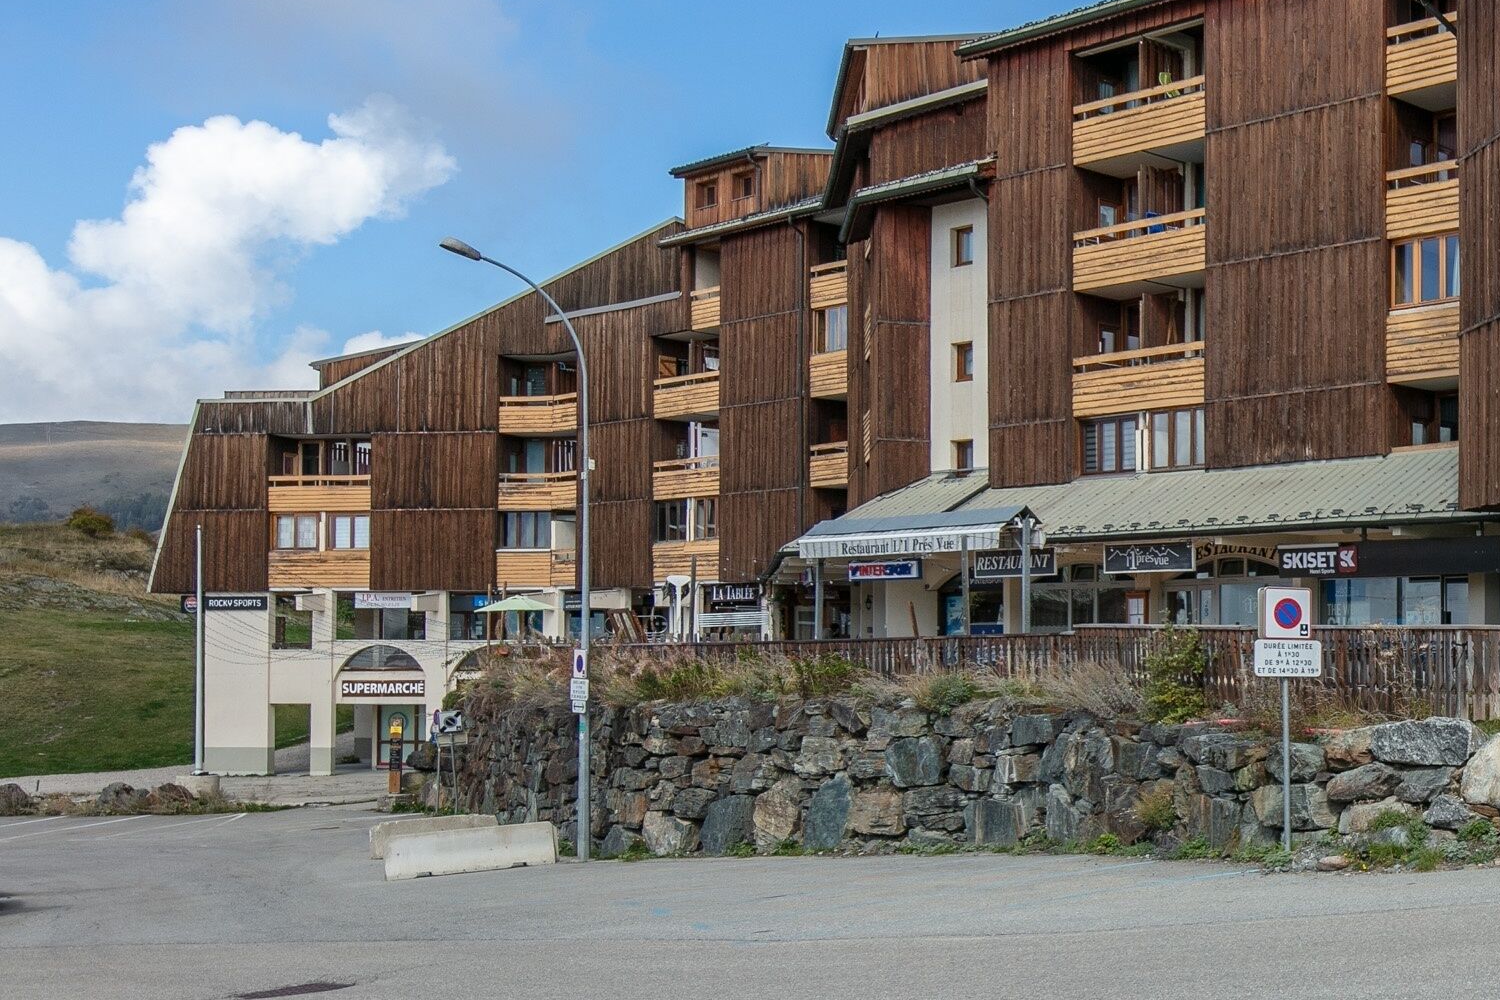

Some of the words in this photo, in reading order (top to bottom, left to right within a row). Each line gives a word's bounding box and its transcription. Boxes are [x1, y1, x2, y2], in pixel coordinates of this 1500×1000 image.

[841, 542, 889, 555] Restaurant
[936, 537, 954, 550] Vue
[1196, 542, 1278, 560] ESTAURANT
[1283, 551, 1337, 569] SKISET
[208, 599, 233, 607] ROCKY
[234, 599, 261, 607] SPORTS
[1264, 641, 1286, 649] DURÉE
[1288, 642, 1313, 650] LIMITÉE
[342, 680, 424, 694] SUPERMARCHÉ
